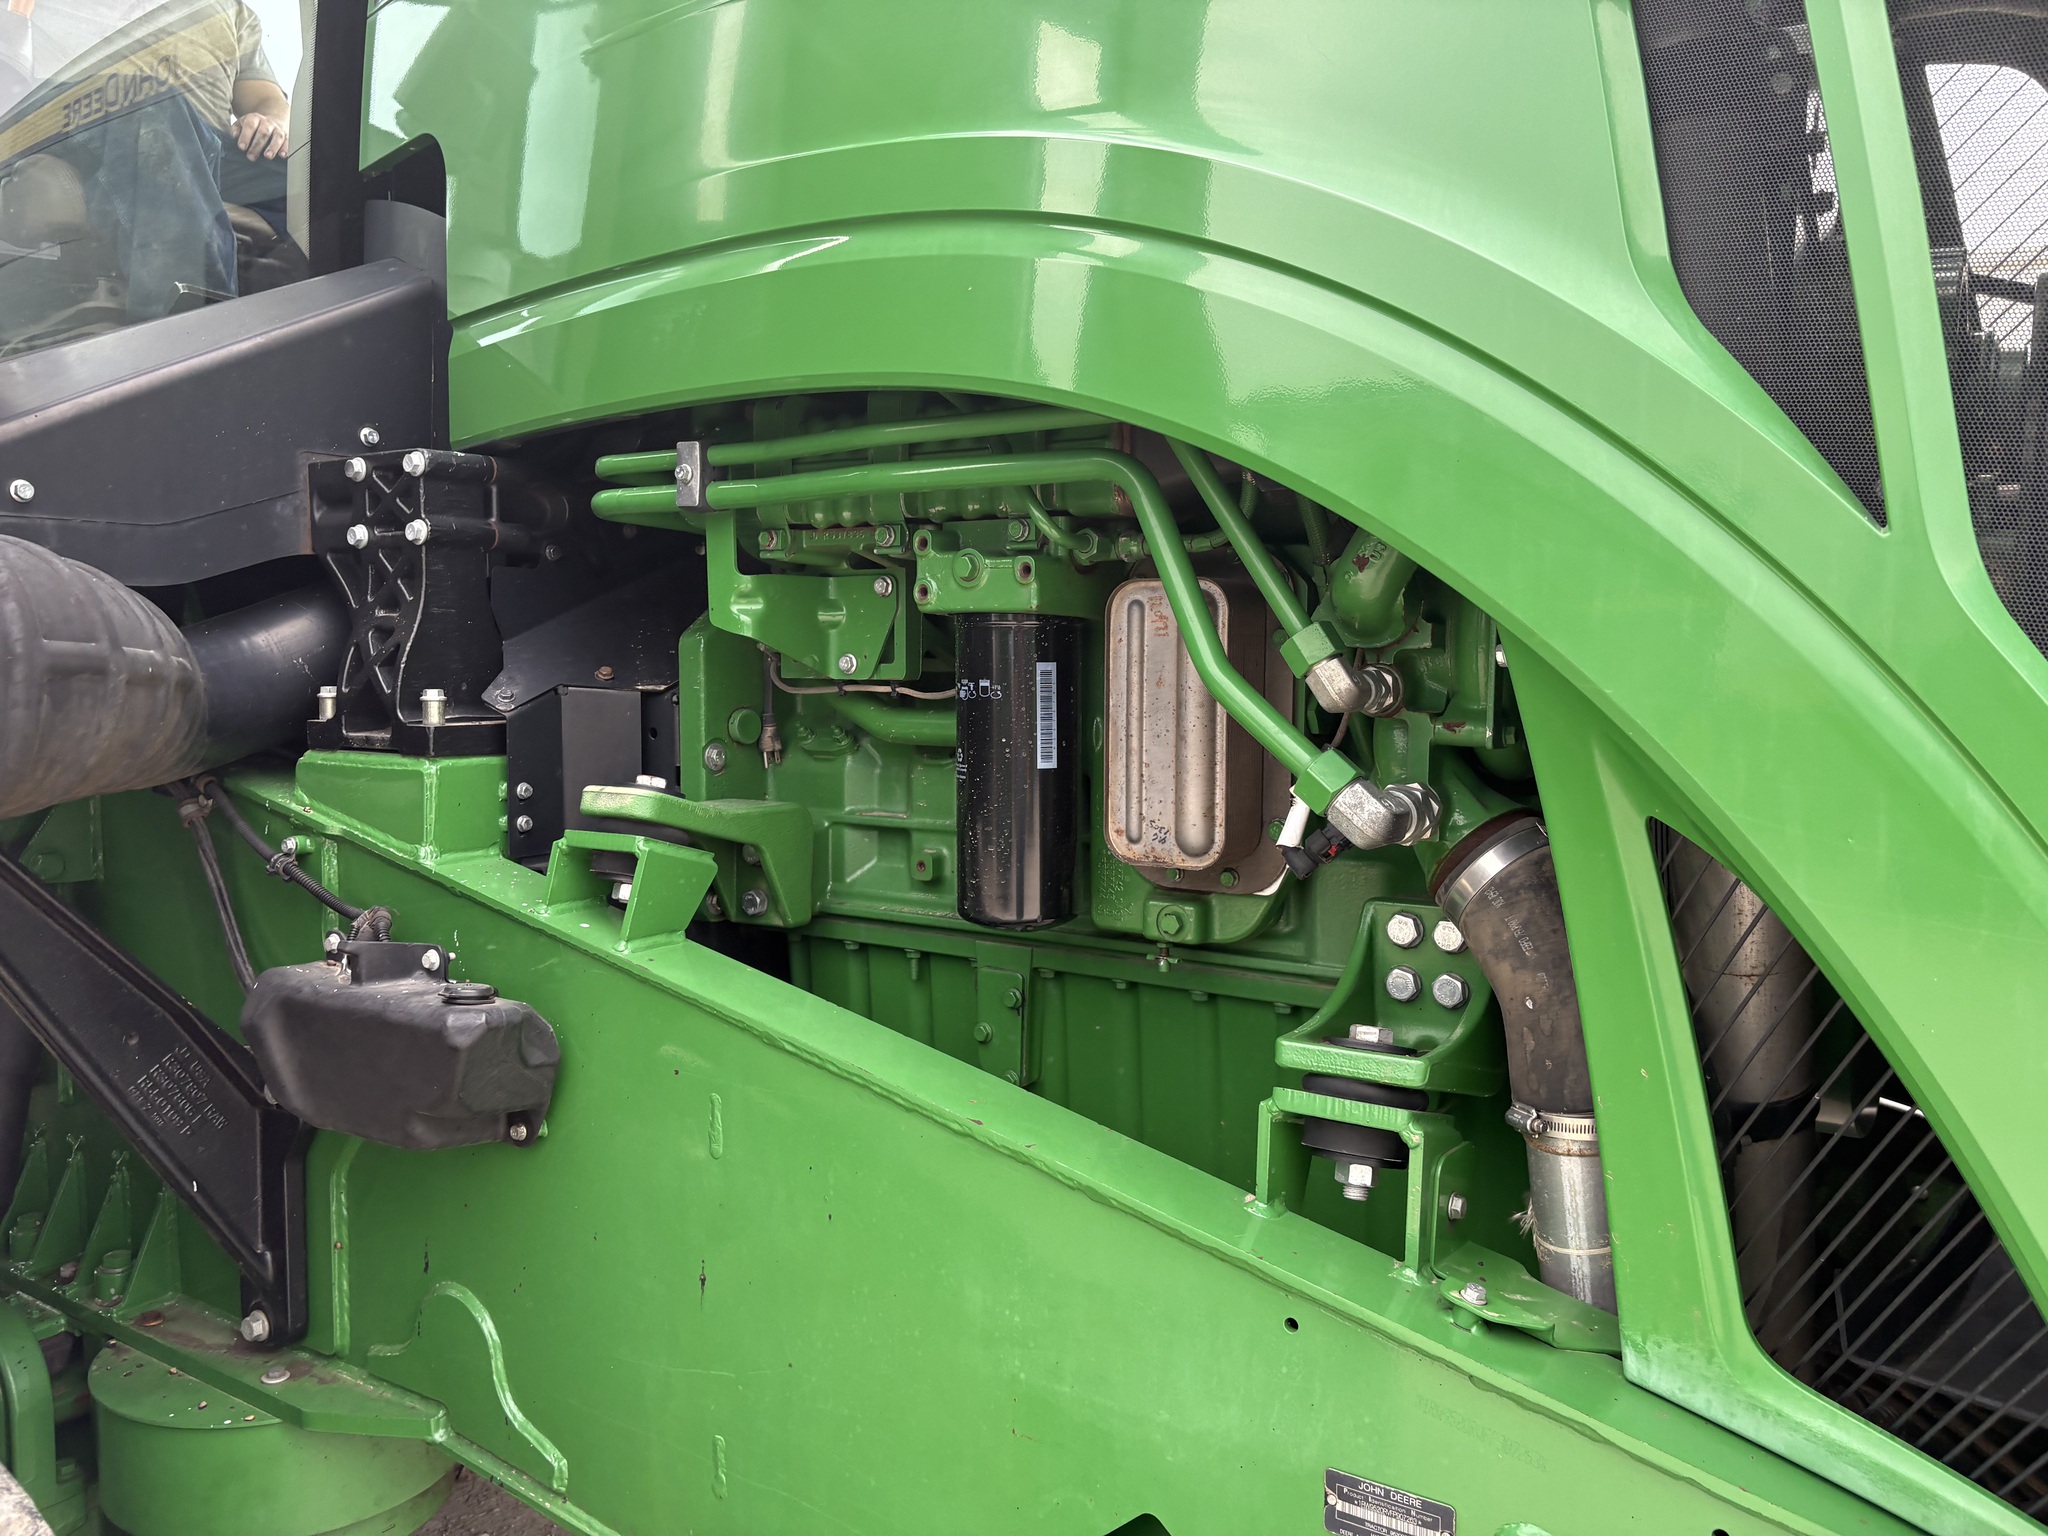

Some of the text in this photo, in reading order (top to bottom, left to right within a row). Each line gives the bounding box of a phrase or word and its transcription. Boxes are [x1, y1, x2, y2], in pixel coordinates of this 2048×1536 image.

[1343, 1487, 1434, 1523] Product Identification Number
[1358, 1482, 1423, 1509] JOHN DEERE
[1364, 1521, 1388, 1534] TRACTOR
